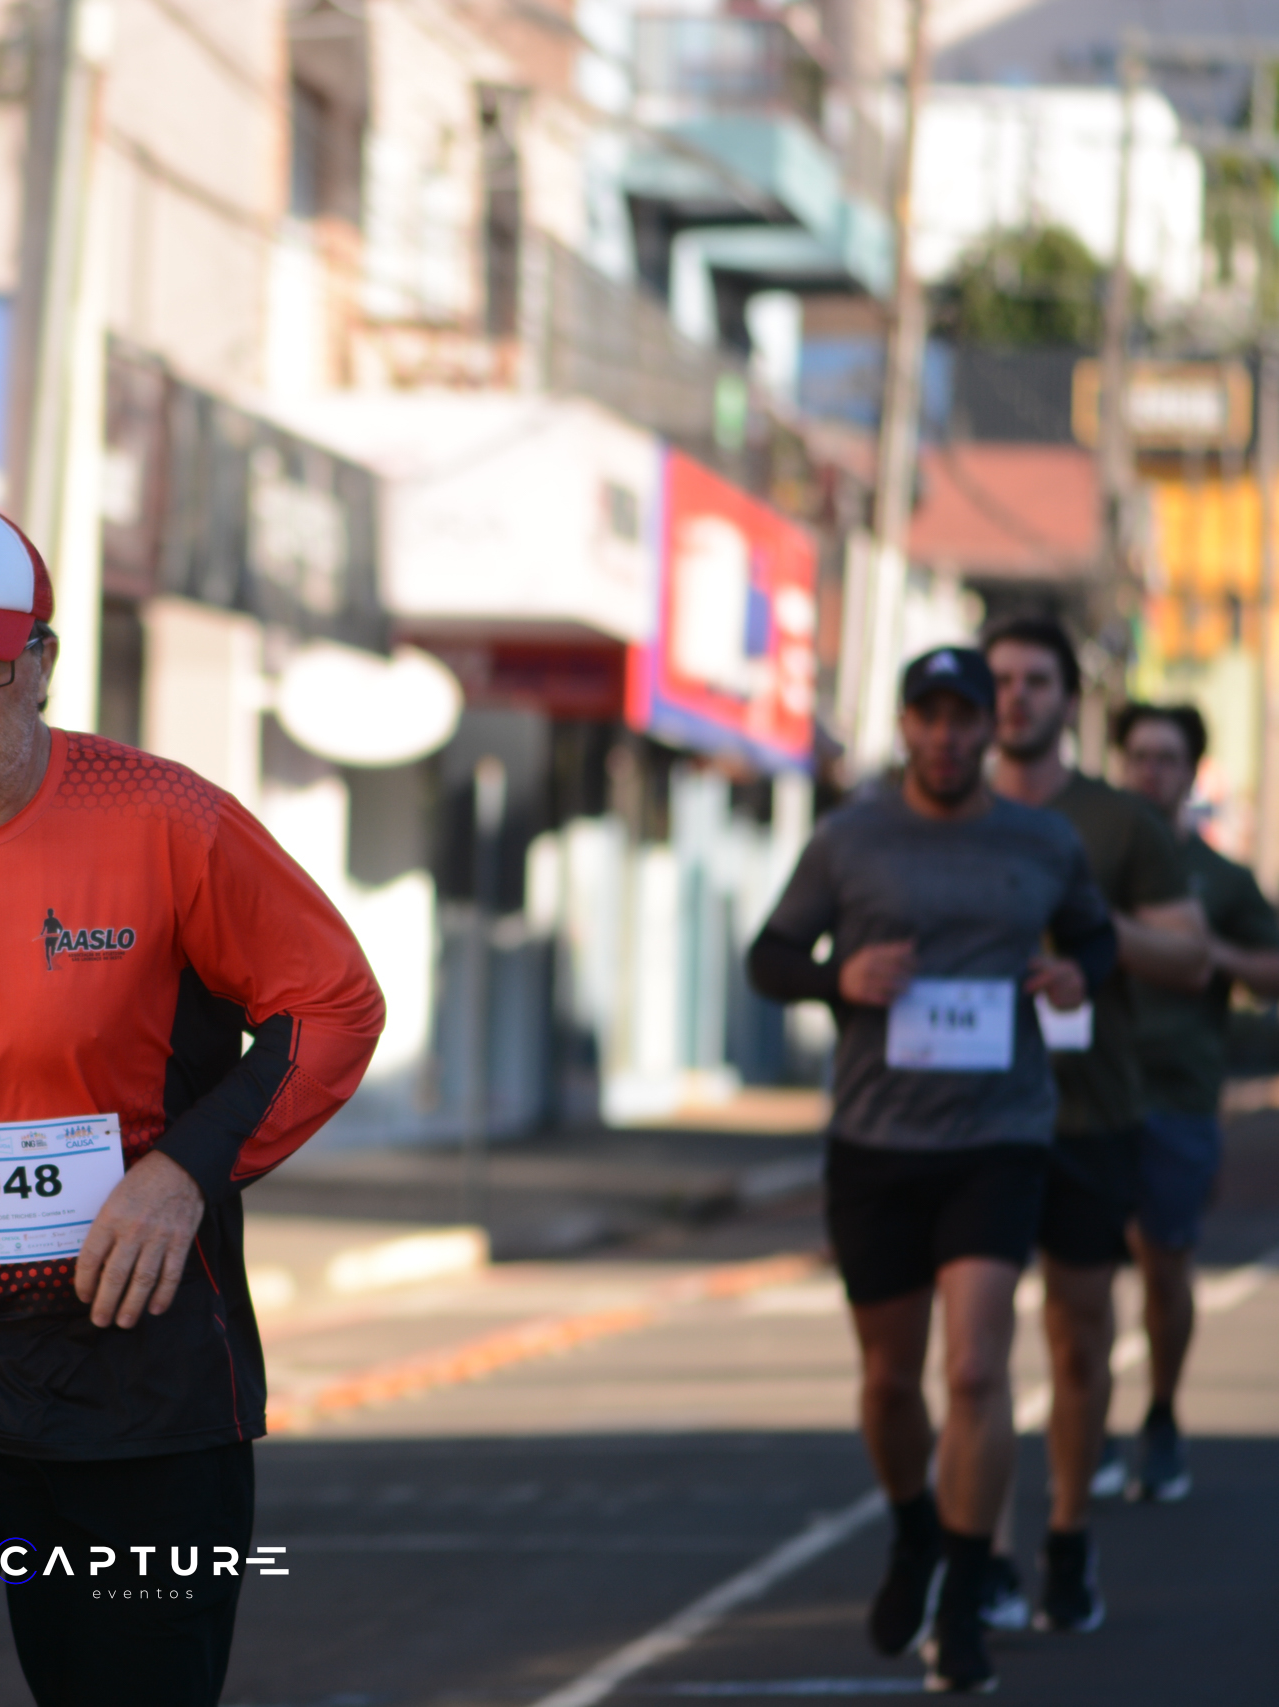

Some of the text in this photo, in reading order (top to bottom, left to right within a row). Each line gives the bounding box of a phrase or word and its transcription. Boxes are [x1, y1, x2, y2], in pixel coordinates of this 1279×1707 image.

[55, 927, 136, 952] AASLO
[21, 1140, 36, 1148] ONG
[66, 1138, 94, 1149] CAUSA
